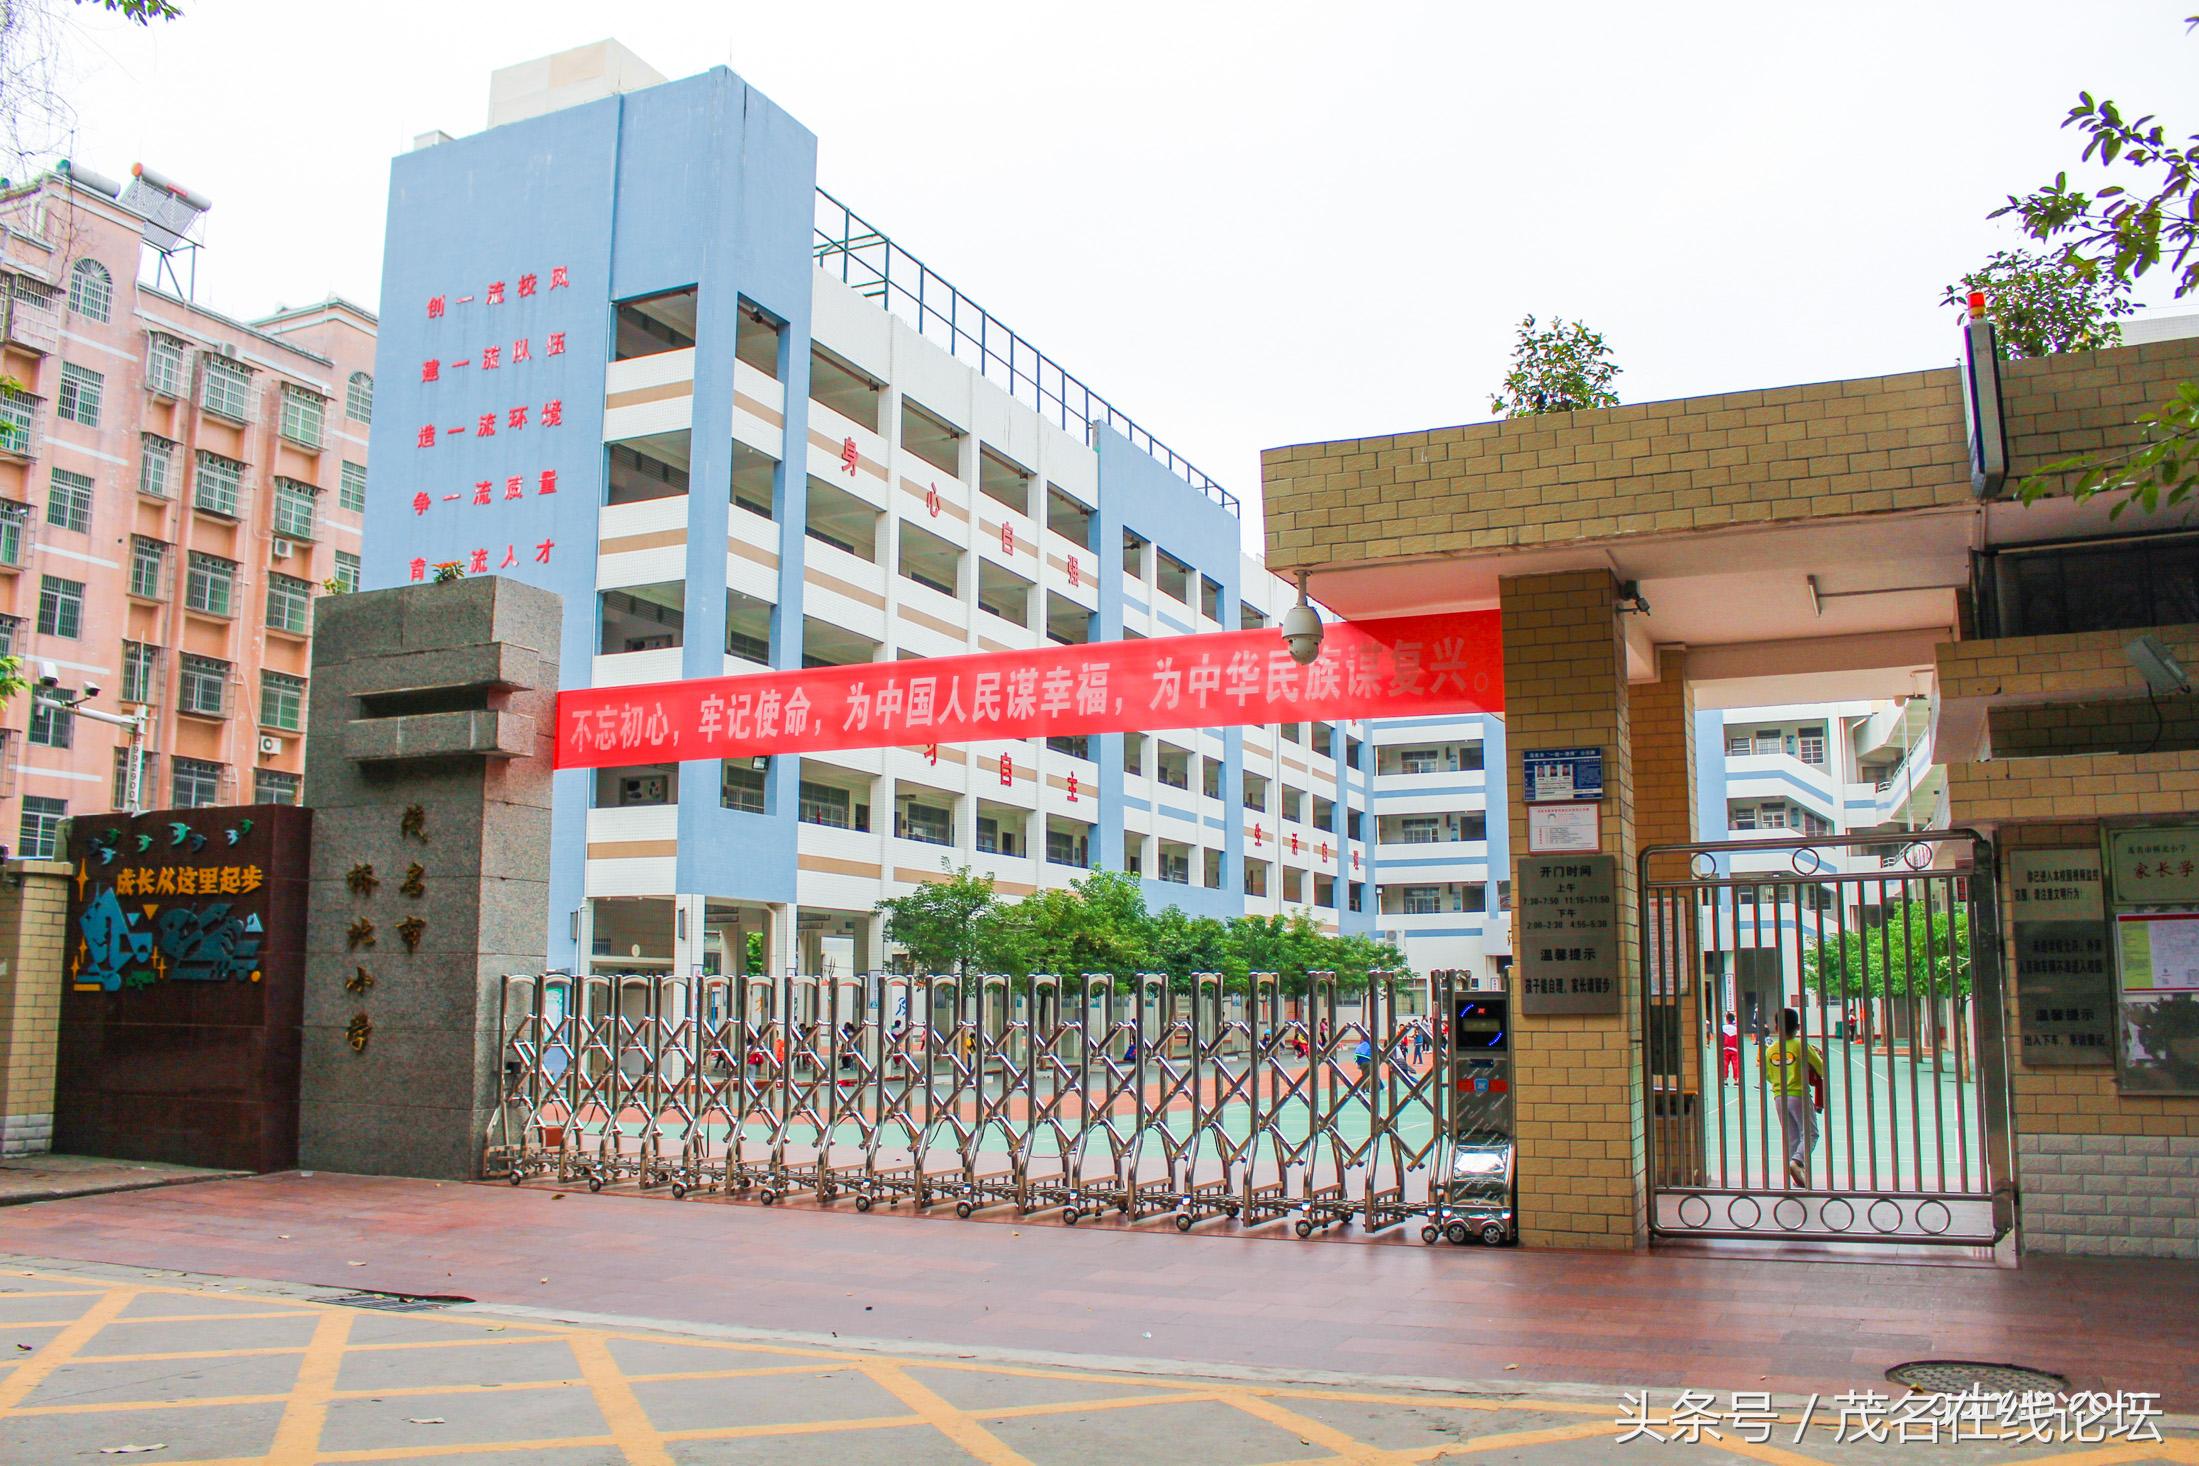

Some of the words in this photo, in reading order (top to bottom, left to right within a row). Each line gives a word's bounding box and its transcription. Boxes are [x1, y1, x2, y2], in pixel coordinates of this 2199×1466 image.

[426, 265, 570, 319] 创一流校风
[421, 332, 567, 383] 建一流队伍
[417, 400, 563, 449] 造一流环境
[412, 469, 558, 517] 争一流质量
[116, 864, 264, 896] 成长从这里起步
[1540, 865, 1592, 878] 开门时间
[1557, 884, 1577, 893] 上午
[1557, 909, 1577, 919] 下午
[1540, 949, 1597, 962] 温馨提示
